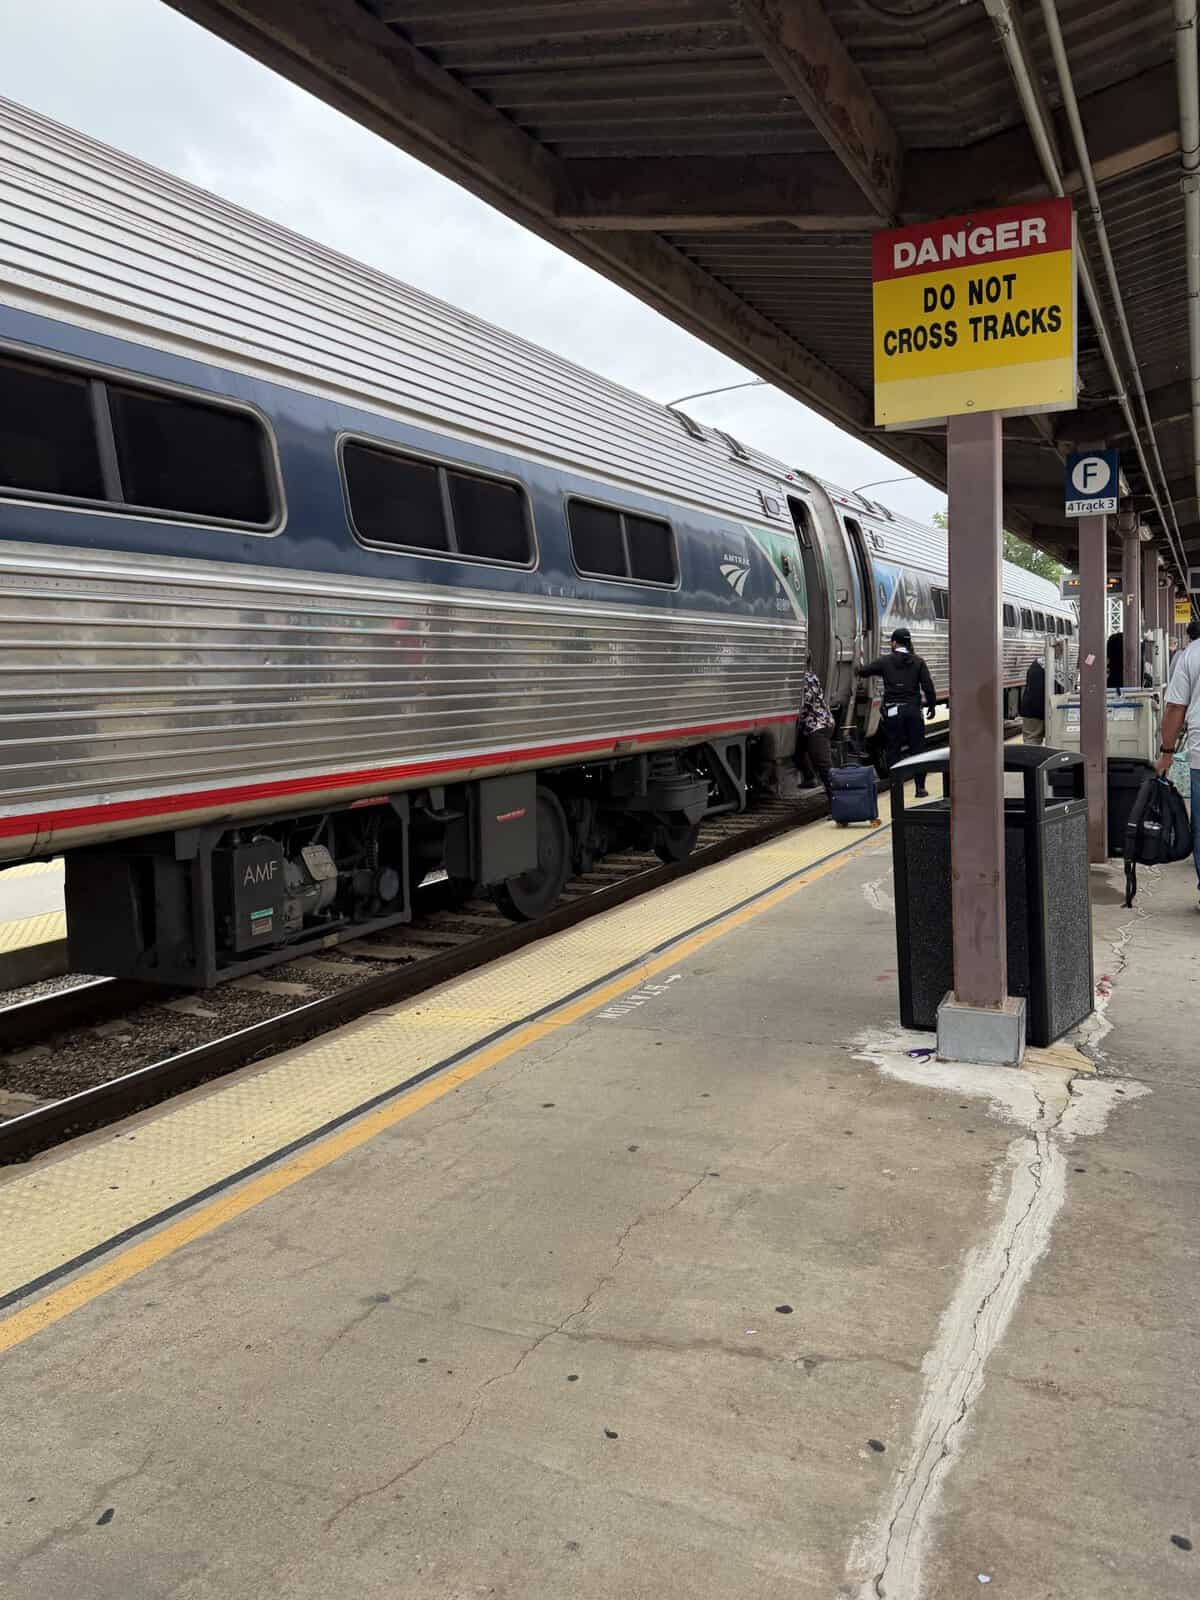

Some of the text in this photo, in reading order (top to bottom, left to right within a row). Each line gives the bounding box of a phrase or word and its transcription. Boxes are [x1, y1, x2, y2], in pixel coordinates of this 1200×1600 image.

[893, 217, 1047, 270] DANGER
[924, 273, 1017, 313] DO NOT
[884, 305, 1062, 356] CROSS TRACKS
[1083, 462, 1098, 489] F
[1076, 499, 1105, 512] Track
[1107, 498, 1115, 509] 3
[243, 860, 280, 888] AMF
